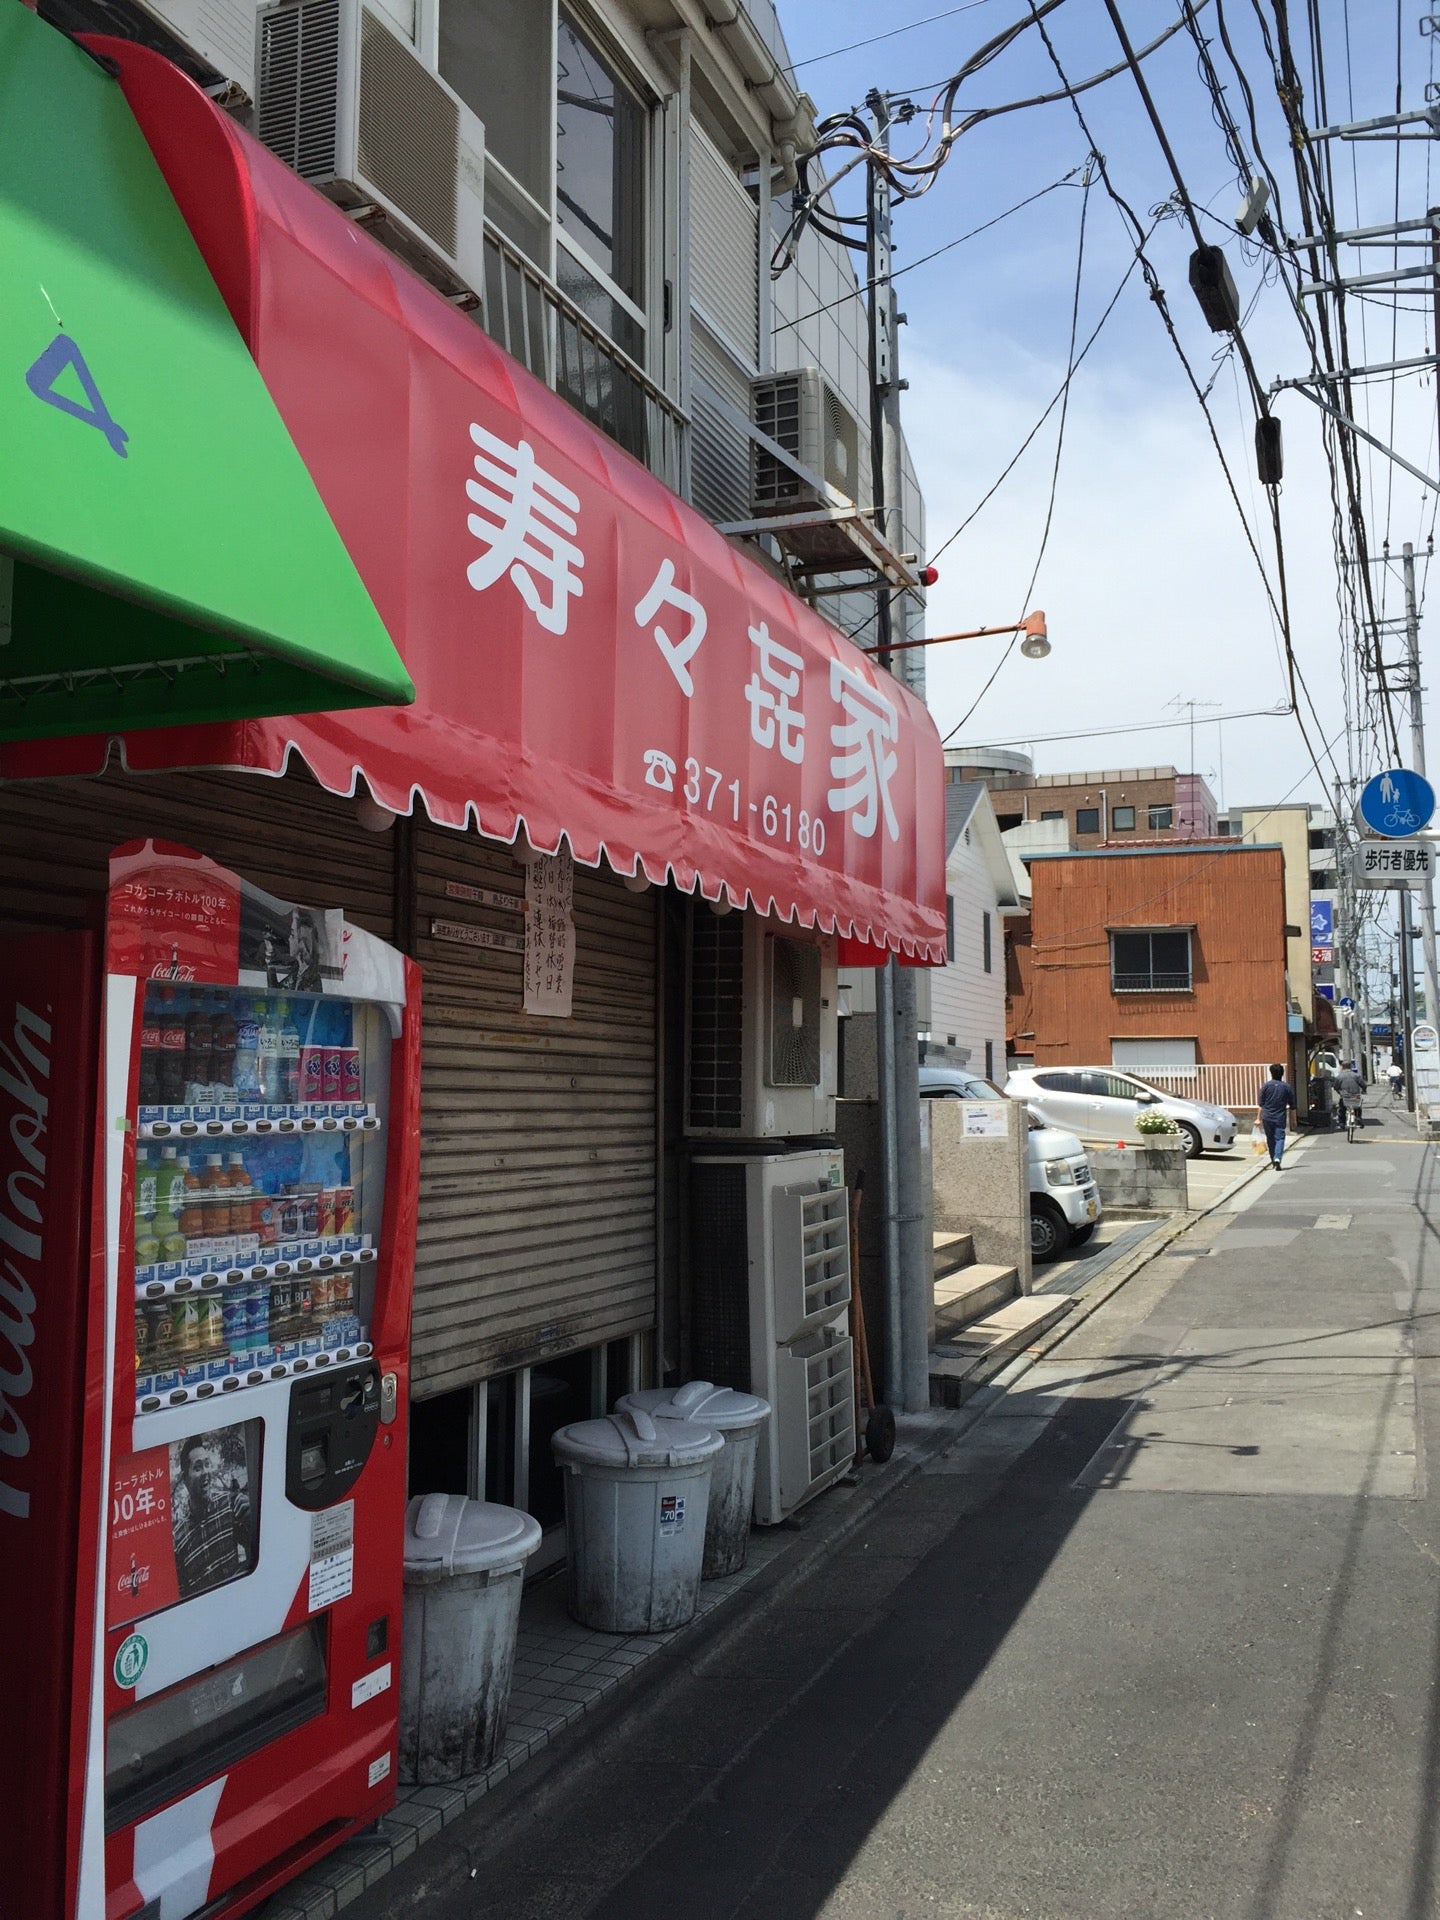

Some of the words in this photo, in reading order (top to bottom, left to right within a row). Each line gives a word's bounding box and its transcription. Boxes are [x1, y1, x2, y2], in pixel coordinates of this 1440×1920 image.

[683, 756, 826, 857] 371-6180
[1365, 848, 1429, 871] 歩行者優先
